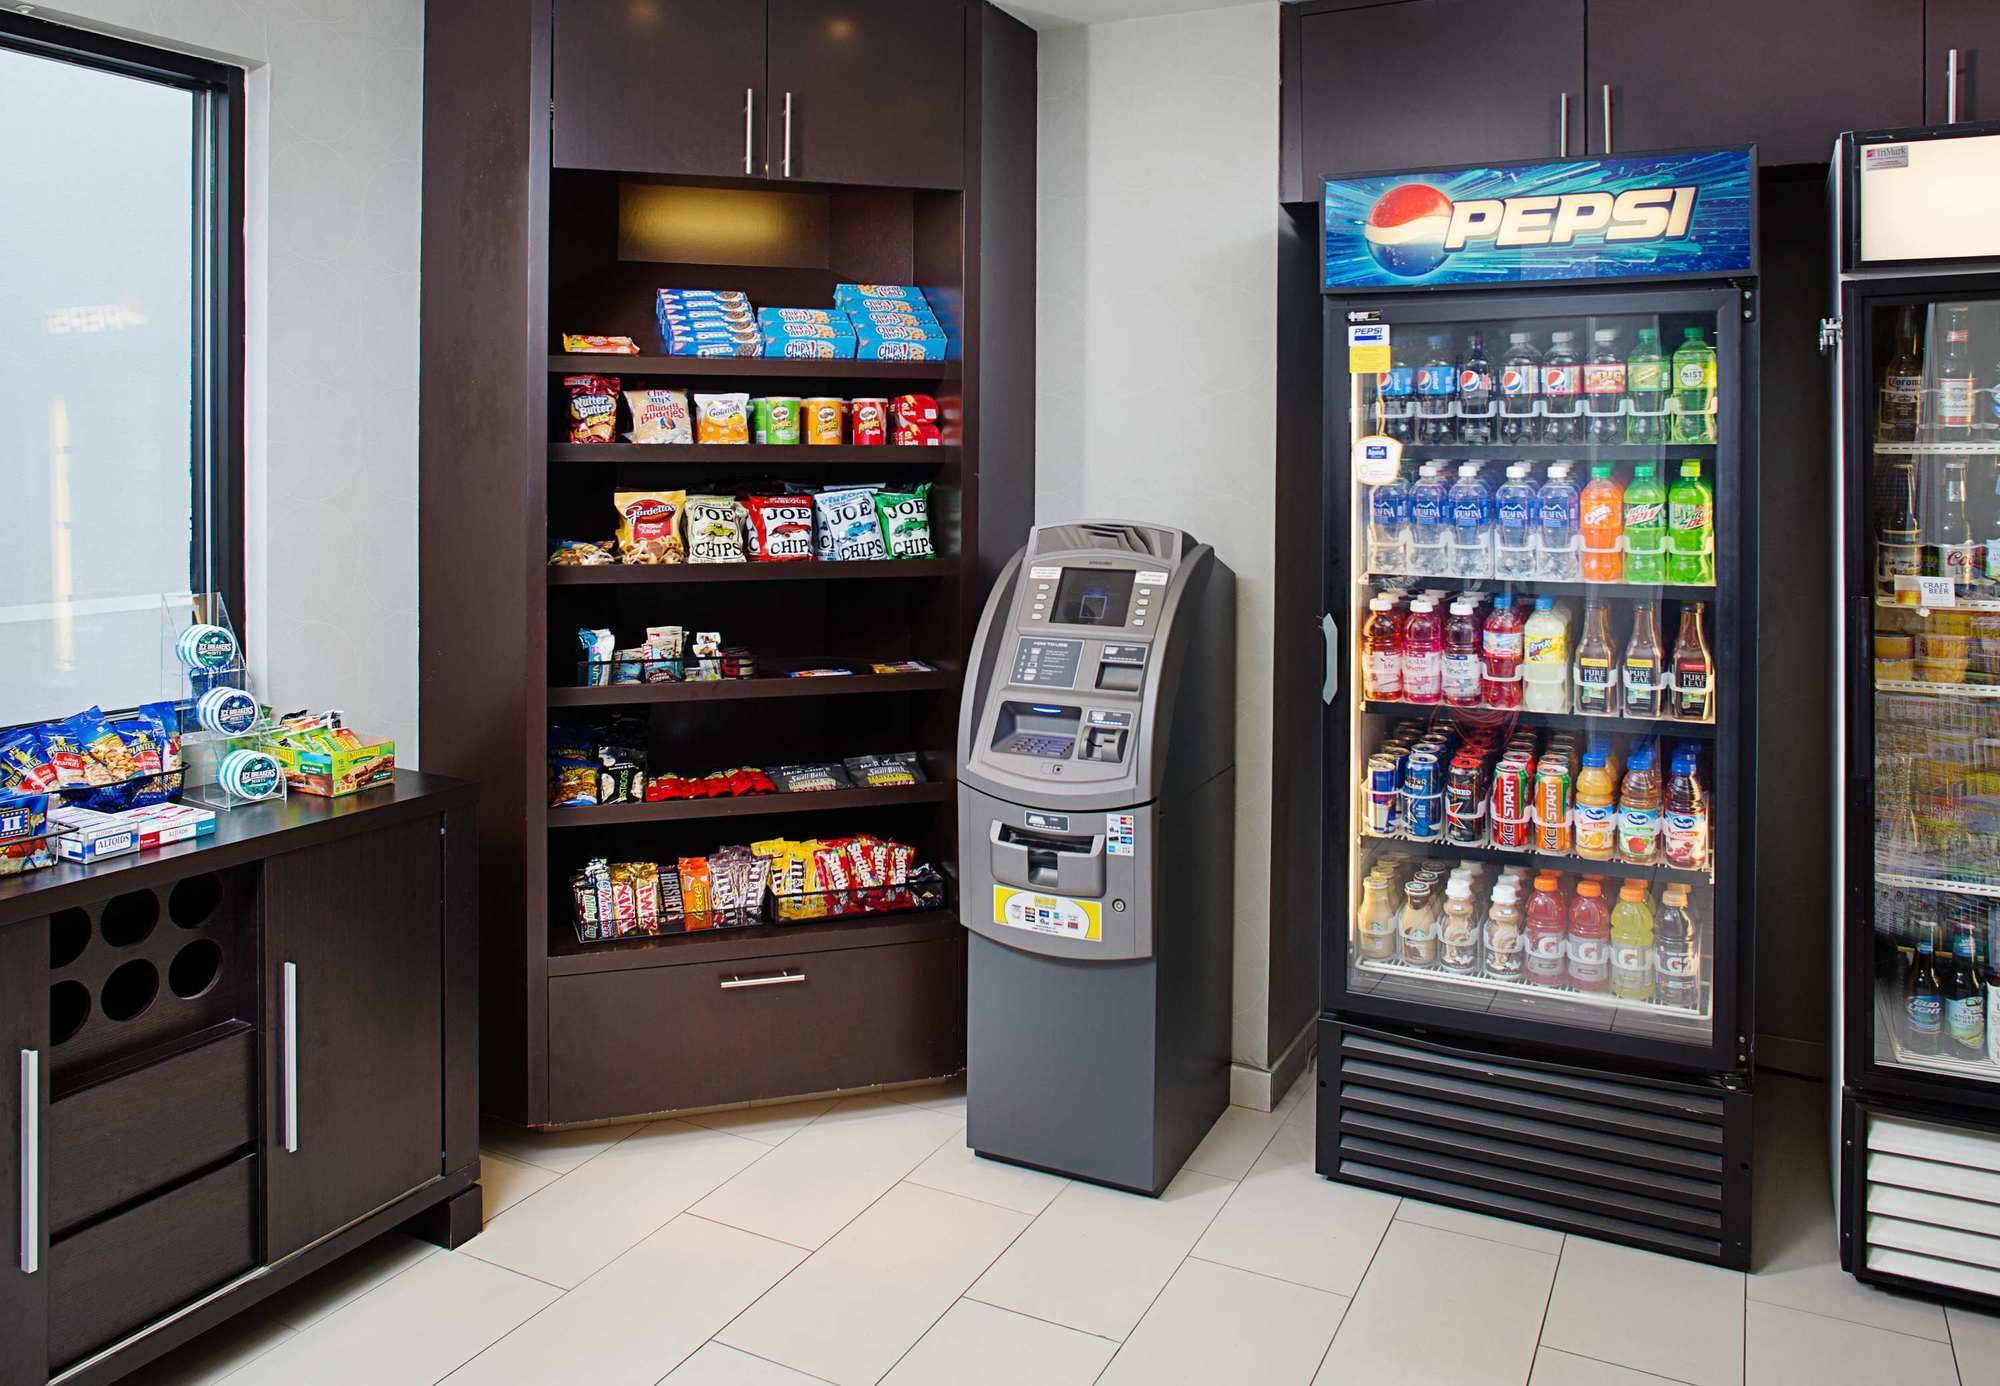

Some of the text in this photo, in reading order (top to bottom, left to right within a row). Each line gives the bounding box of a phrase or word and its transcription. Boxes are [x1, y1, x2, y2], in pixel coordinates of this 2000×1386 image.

[1444, 186, 1697, 250] PEPSI
[1354, 326, 1383, 335] PEPSI
[573, 396, 608, 408] Nutter
[579, 404, 613, 418] Butter
[640, 409, 685, 424] Buddies
[695, 507, 735, 522] JOE
[767, 509, 811, 520] JOE
[831, 501, 872, 525] JOE
[888, 501, 926, 519] JOE
[695, 542, 742, 557] CHIPS
[841, 539, 884, 559] CHIPS
[199, 643, 232, 653] ICE BREAKERS
[1629, 670, 1650, 678] PURE
[1683, 673, 1705, 681] PURE
[221, 706, 254, 719] ICE BREAKERS
[53, 758, 81, 768] Peanuts
[242, 769, 276, 782] ICE BREAKERS
[2, 816, 22, 833] II
[97, 834, 130, 850] ALTOIDS
[660, 872, 685, 921] HERSHEY'S
[585, 895, 597, 921] Milky
[617, 883, 637, 934] TWIX
[637, 884, 658, 930] TWIX
[1538, 937, 1557, 955] G
[1579, 942, 1598, 961] G
[1618, 949, 1638, 968] G
[1907, 1003, 1941, 1015] LIGHT
[1913, 999, 1940, 1008] BUD
